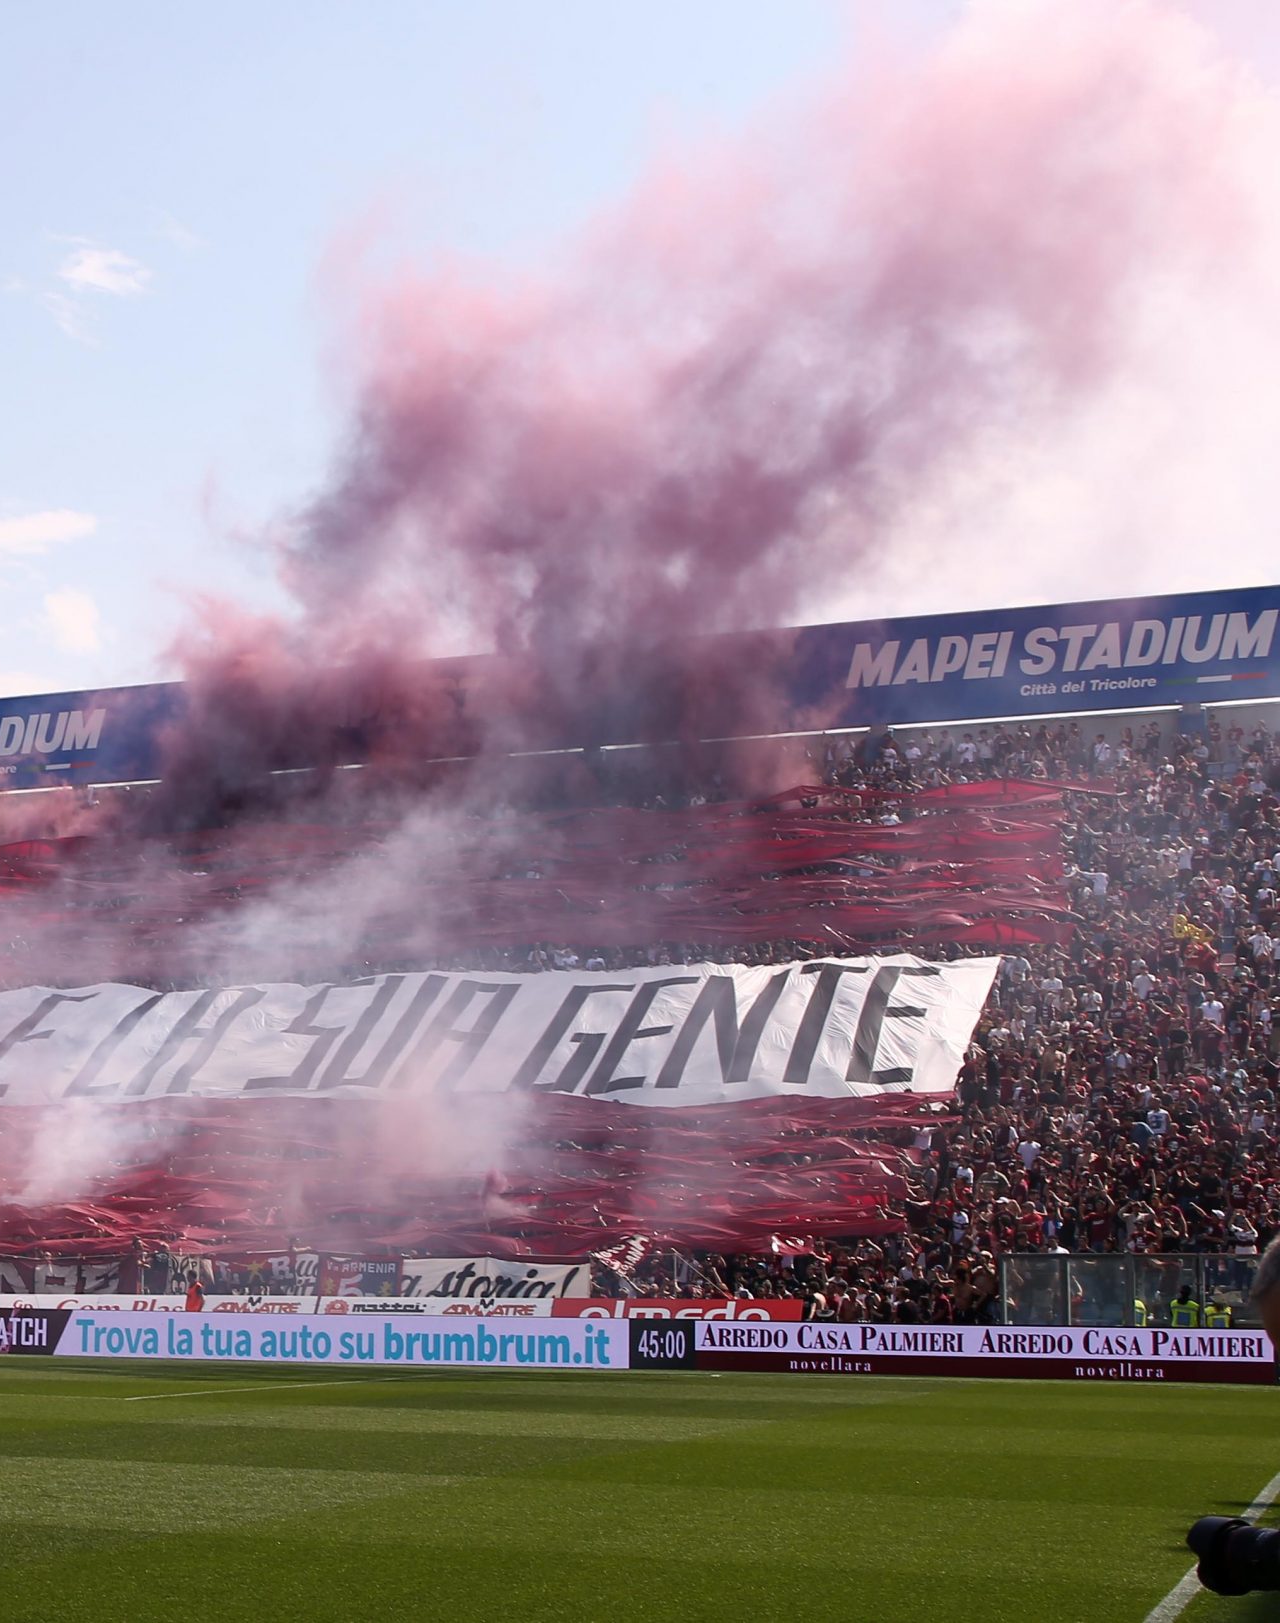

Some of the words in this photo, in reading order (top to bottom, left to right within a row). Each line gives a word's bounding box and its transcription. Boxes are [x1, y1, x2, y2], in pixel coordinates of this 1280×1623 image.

[845, 631, 1014, 689] MAPEI
[1019, 609, 1279, 676] STADIUM
[1020, 682, 1058, 697] Città
[1061, 680, 1086, 694] del
[1089, 676, 1158, 692] Tricolore
[64, 987, 269, 1096] LA
[242, 975, 523, 1093] SUA
[523, 962, 942, 1096] GENTE
[342, 1261, 396, 1274] ARMENIA
[427, 1262, 580, 1298] storia!
[75, 1319, 159, 1355] Trova
[168, 1318, 193, 1356] la
[200, 1322, 252, 1358] tua
[260, 1325, 332, 1360] auto
[339, 1331, 375, 1360] su
[384, 1322, 610, 1365] brumbrum.it
[638, 1330, 686, 1359] 45:00
[701, 1323, 789, 1349] ARREDO
[797, 1324, 853, 1350] CASA
[859, 1326, 964, 1353] PALMIERI
[979, 1328, 1074, 1355] ARREDO
[1082, 1329, 1146, 1356] CASA
[1150, 1330, 1265, 1358] PALMIERI
[789, 1357, 872, 1372] novellara
[1075, 1362, 1165, 1378] novellara
